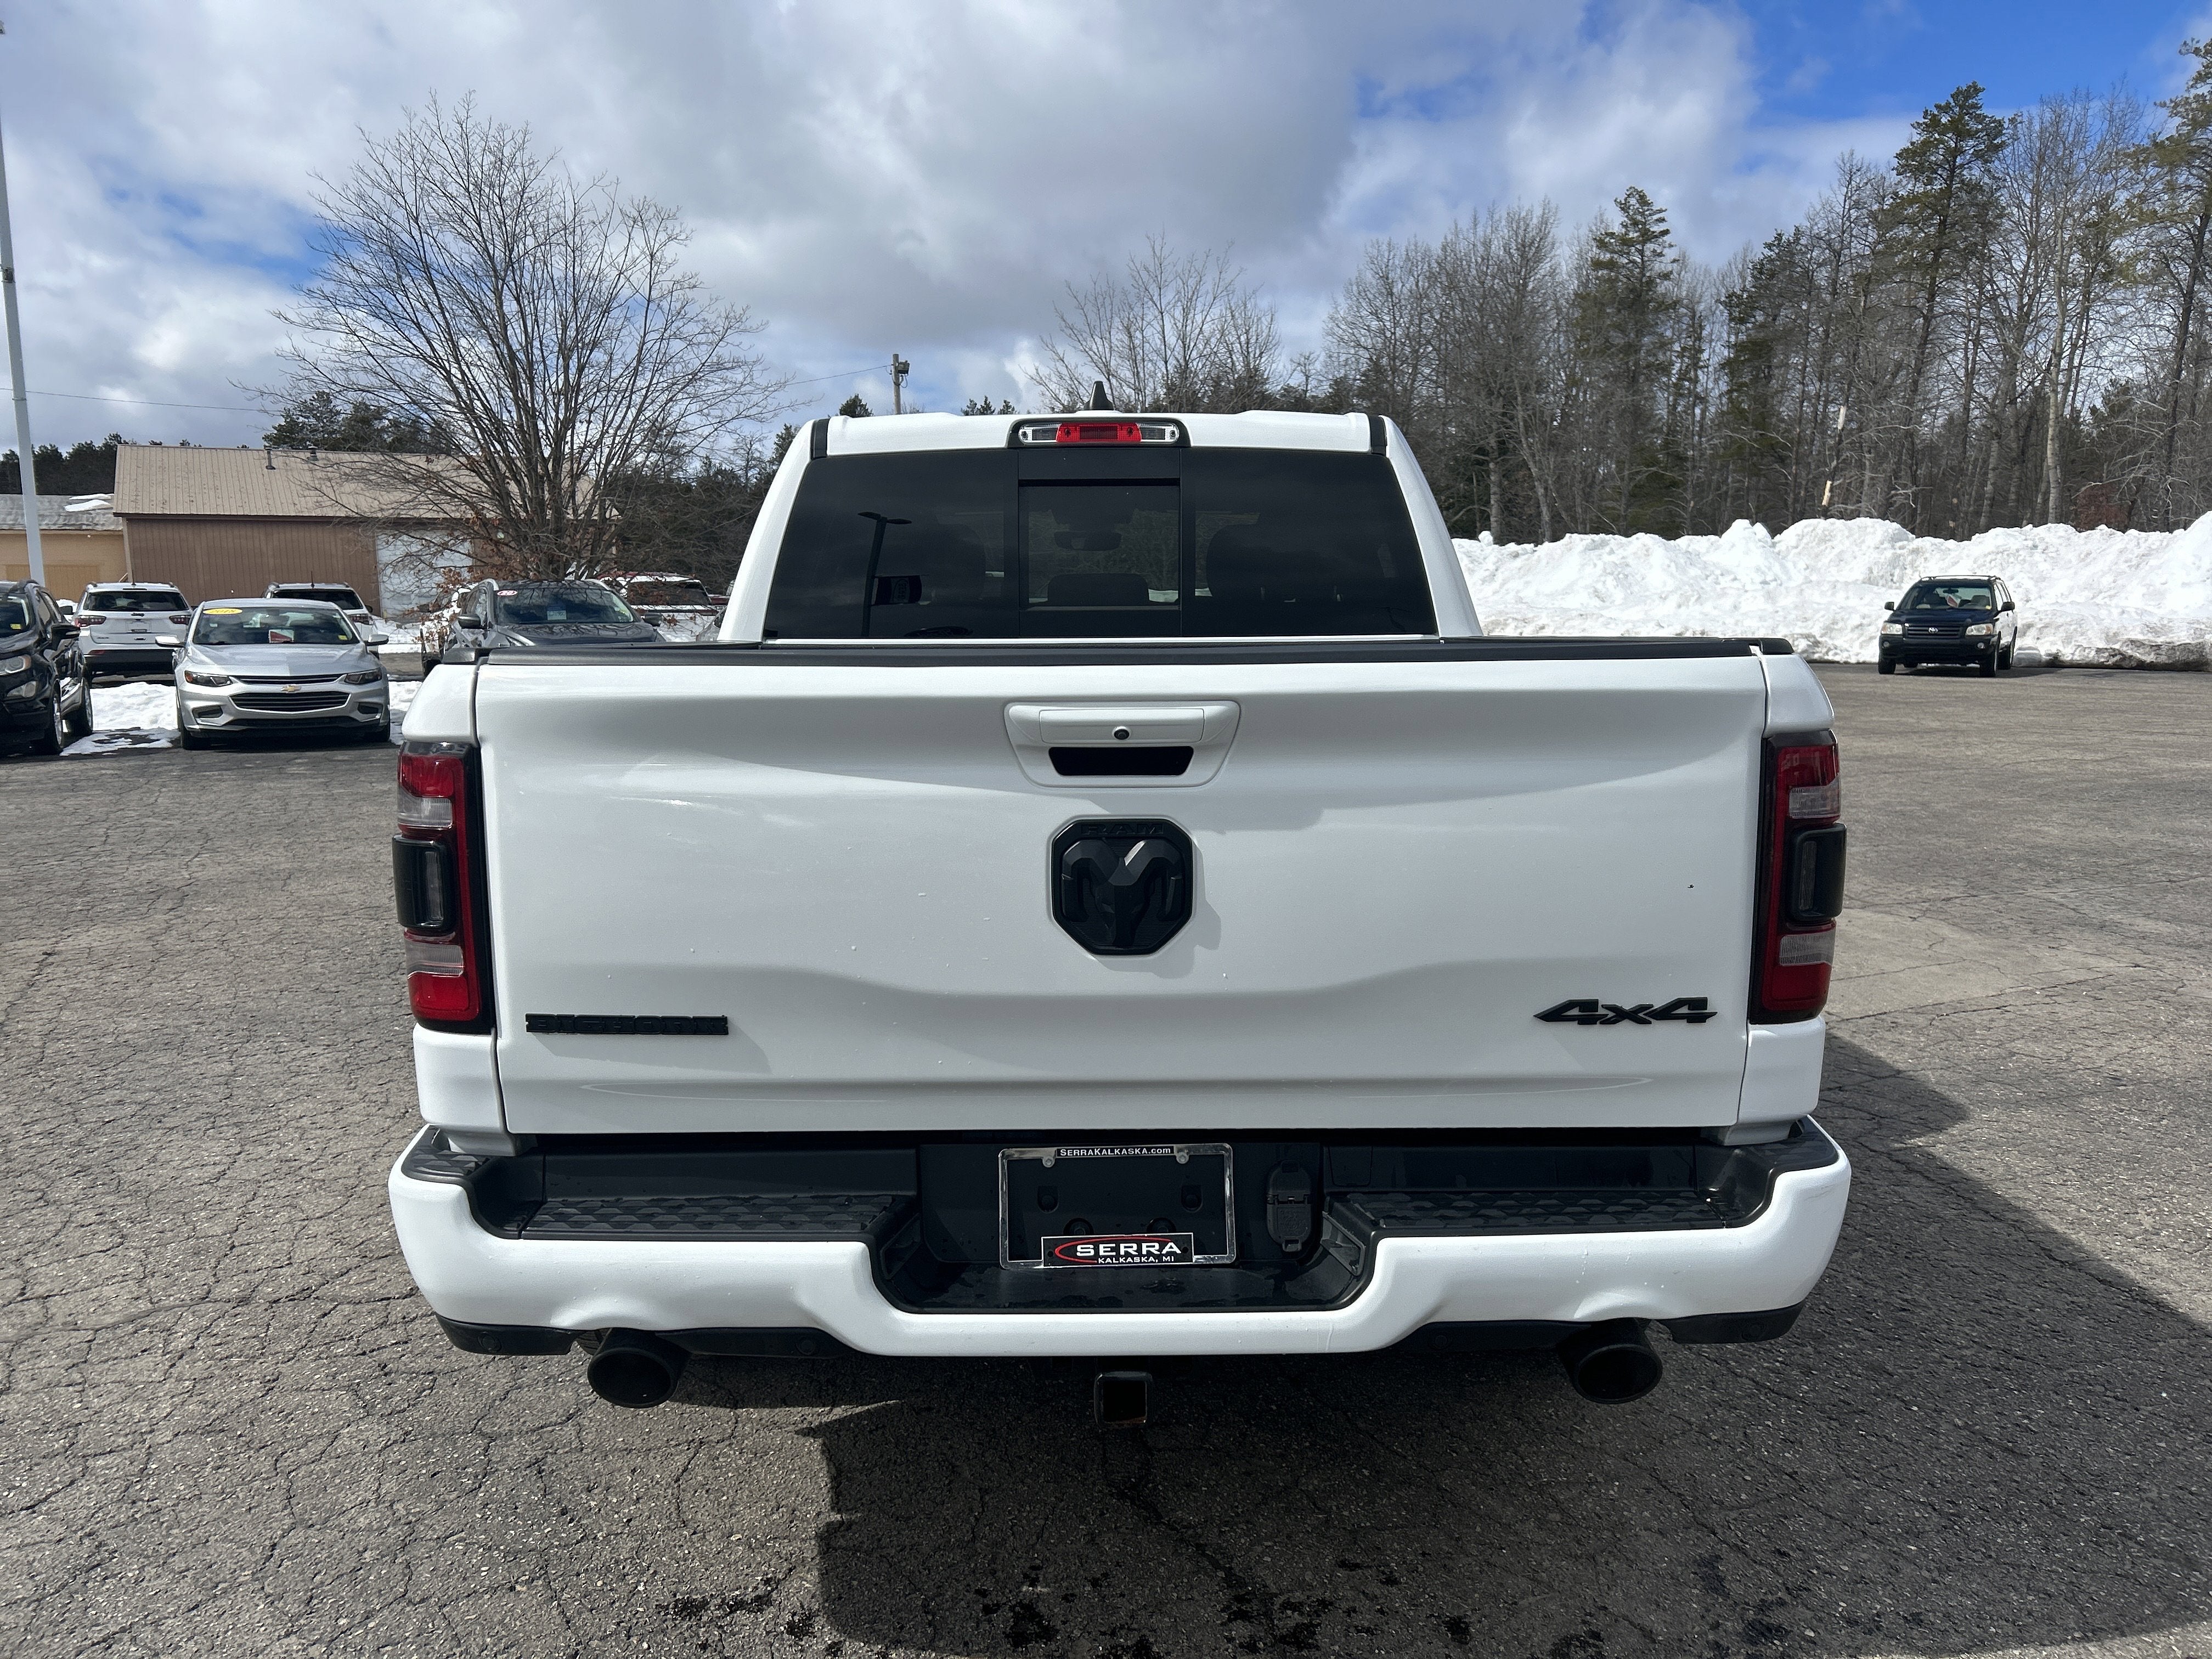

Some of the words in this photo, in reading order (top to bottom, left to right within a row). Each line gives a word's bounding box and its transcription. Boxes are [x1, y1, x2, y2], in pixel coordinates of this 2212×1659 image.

[1080, 823, 1164, 836] RAM
[1533, 997, 1718, 1025] 4x4
[1076, 1242, 1182, 1256] SERRA
